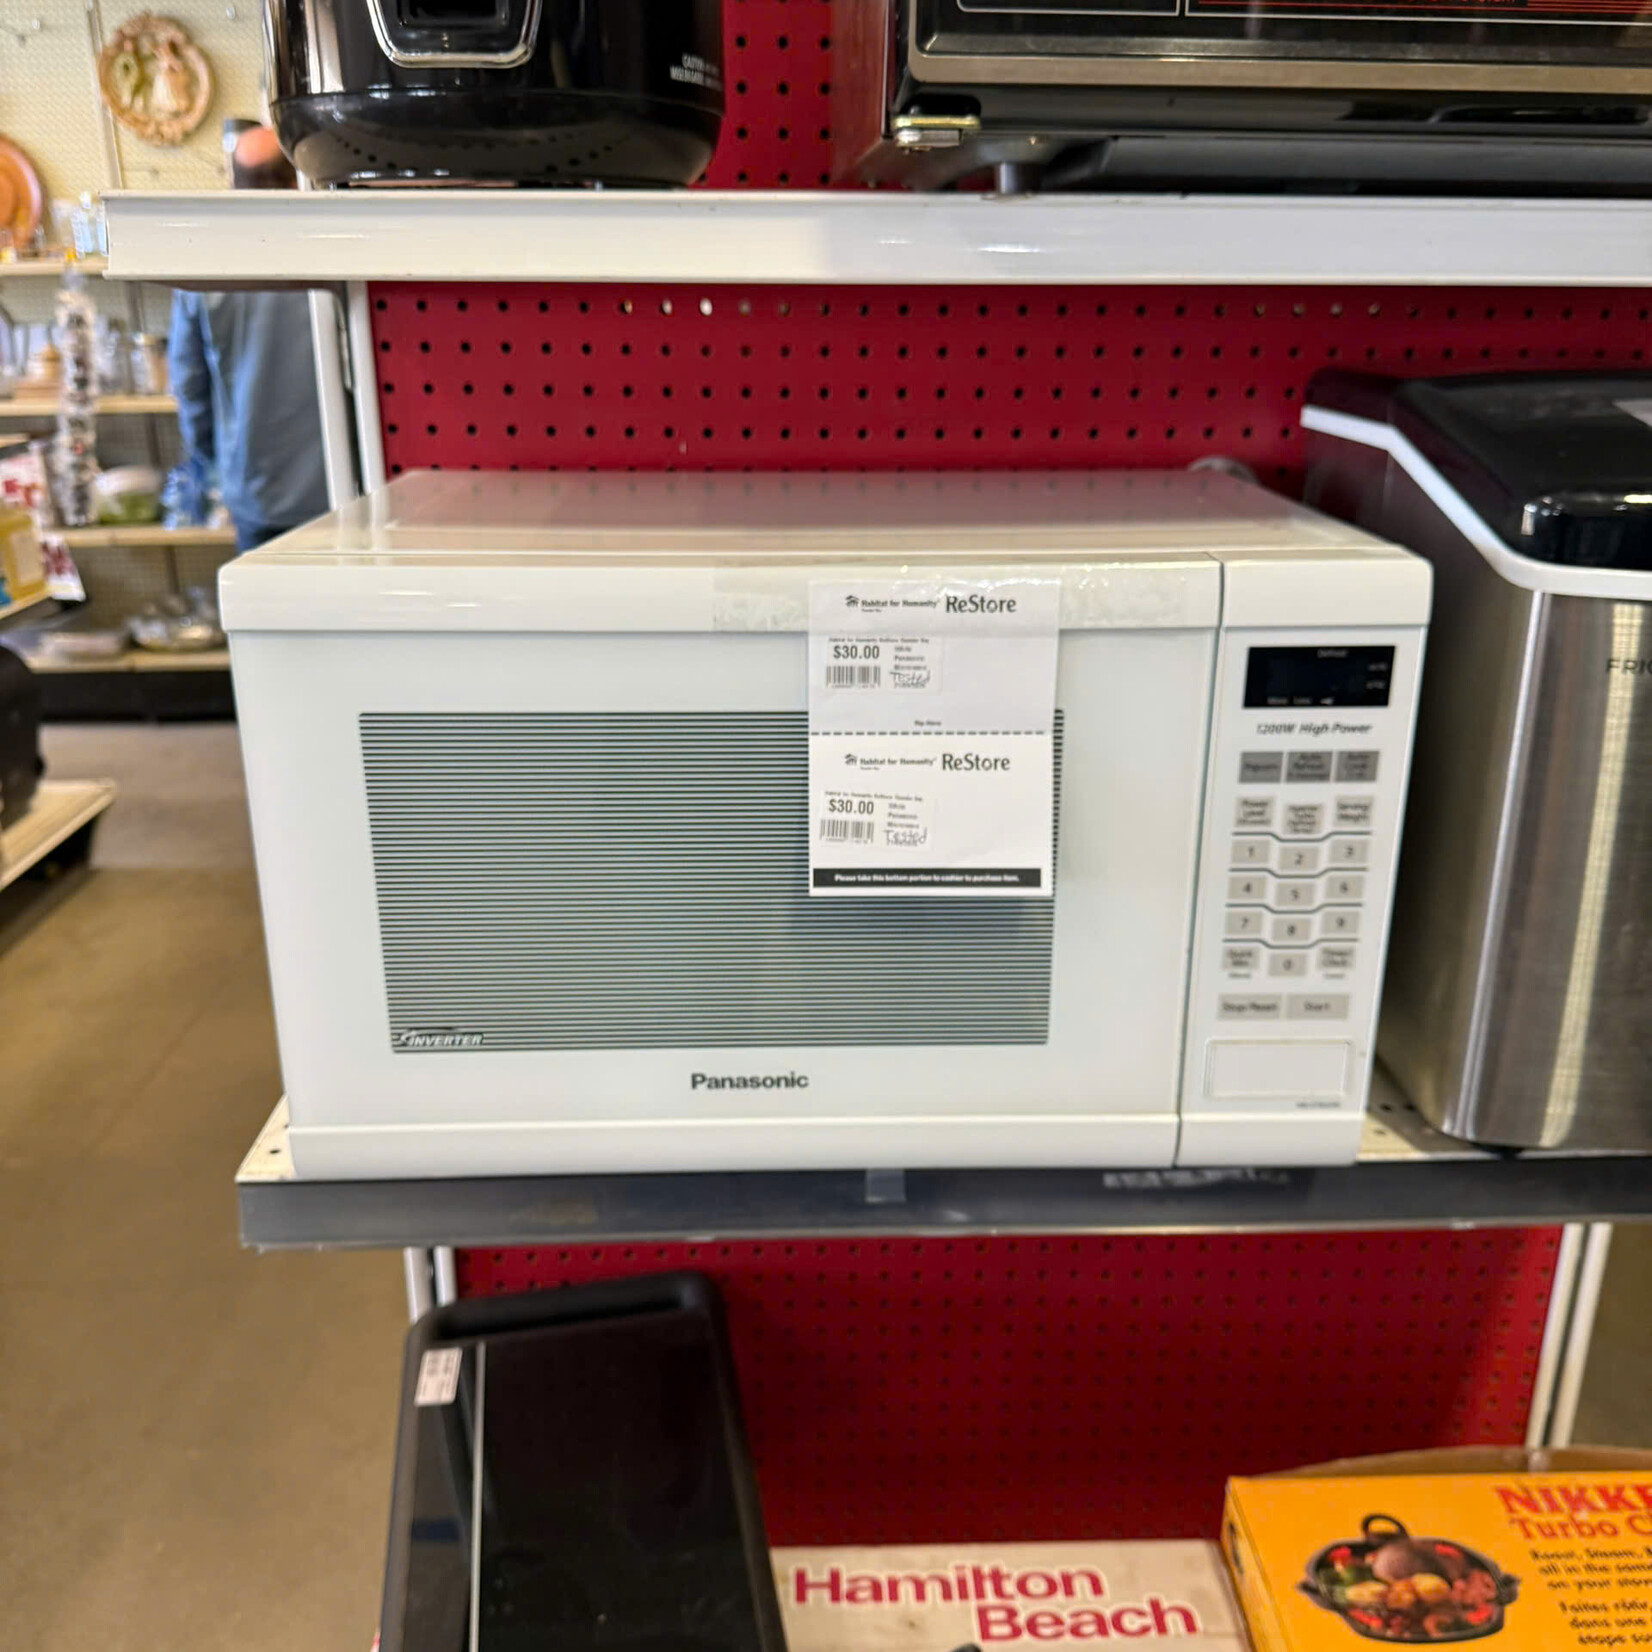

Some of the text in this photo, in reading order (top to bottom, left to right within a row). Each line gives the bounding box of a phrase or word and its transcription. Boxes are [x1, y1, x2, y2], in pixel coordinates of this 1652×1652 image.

[946, 594, 1016, 613] ReStore
[833, 645, 880, 659] $30.00
[1300, 724, 1329, 736] High
[1332, 723, 1372, 733] Power
[942, 753, 1011, 771] ReStore
[828, 799, 875, 815] $30.00
[1345, 847, 1354, 858] 3
[1295, 854, 1303, 866] 2
[1243, 883, 1252, 893] 4
[1291, 889, 1299, 900] 5
[1242, 918, 1249, 928] 7
[1336, 918, 1345, 928] 9
[1283, 960, 1292, 970] 0
[405, 1033, 483, 1047] INVERTER
[691, 1071, 809, 1089] Panasonic
[1511, 1514, 1618, 1539] Turbo
[794, 1564, 1105, 1604] Hamilton
[975, 1599, 1199, 1641] Beach
